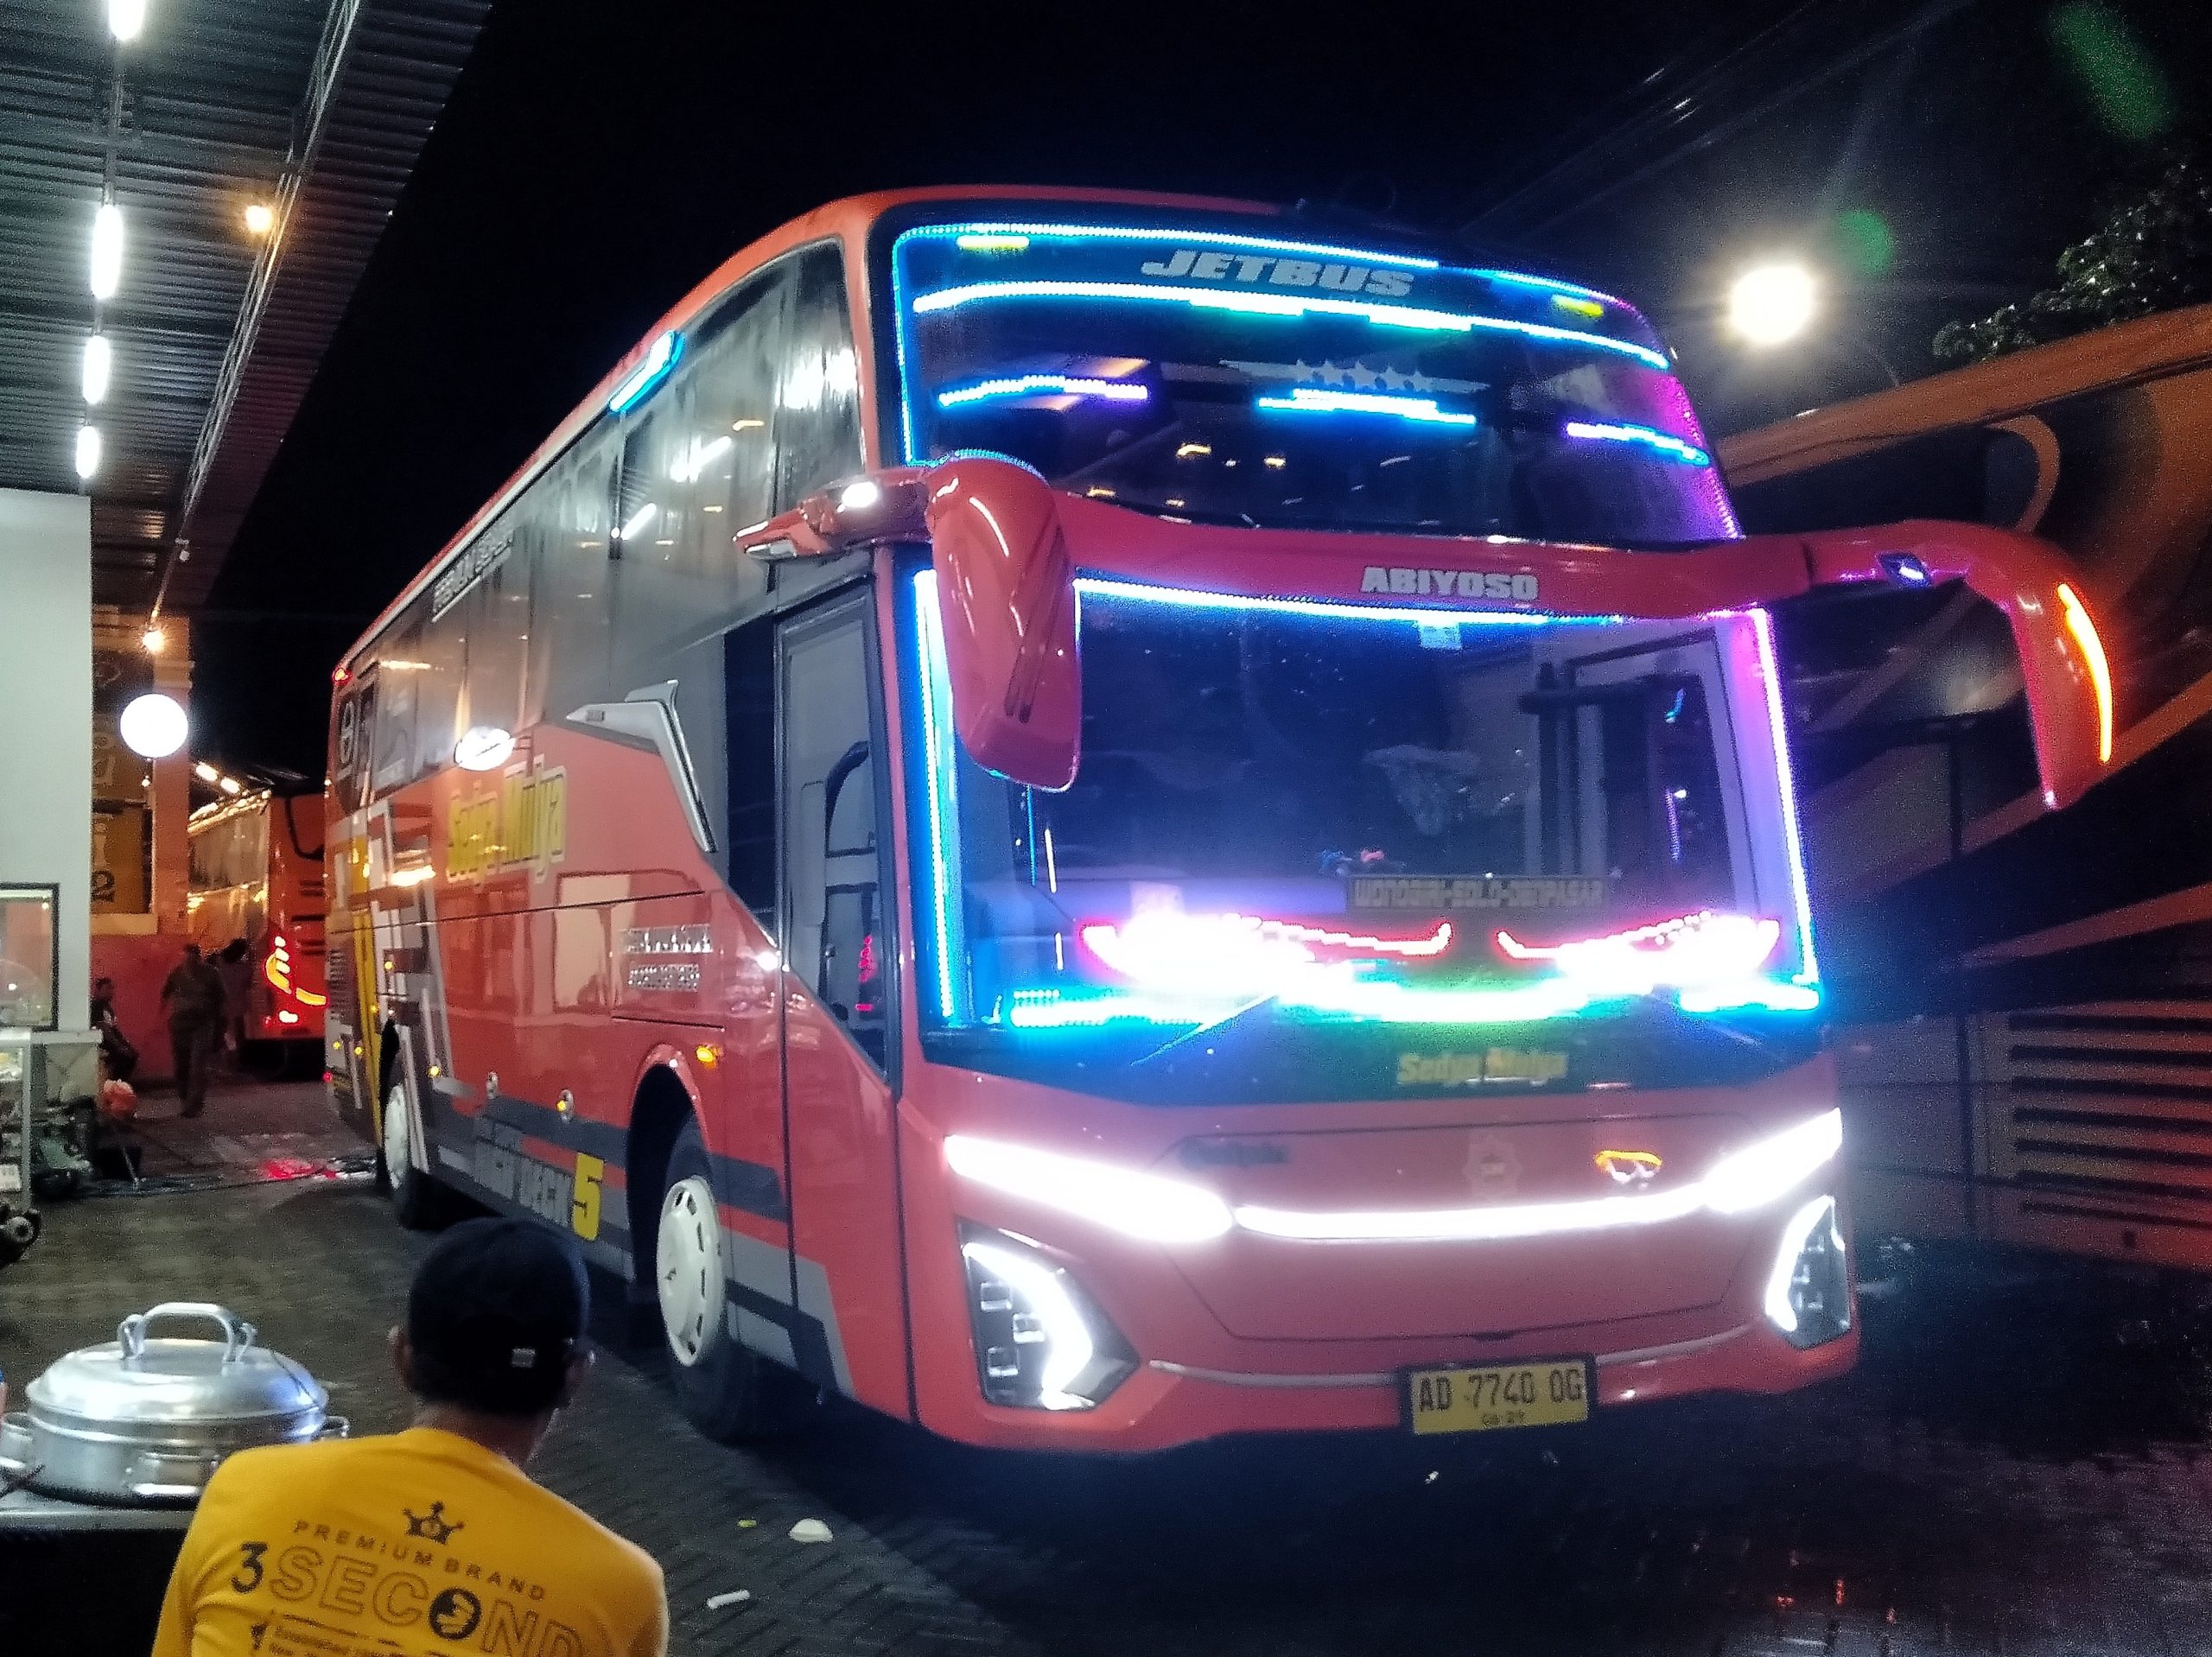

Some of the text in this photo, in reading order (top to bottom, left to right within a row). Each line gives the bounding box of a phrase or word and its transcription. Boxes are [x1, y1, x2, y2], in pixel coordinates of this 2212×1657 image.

[1141, 249, 1414, 296] JETBUS
[1360, 566, 1538, 600] ABIYOSO
[573, 1152, 604, 1241] 5
[1420, 1375, 1452, 1412] AD
[1469, 1370, 1535, 1408] 7740
[232, 1541, 269, 1594] 3
[294, 1520, 546, 1601] PREMIUM BRAND
